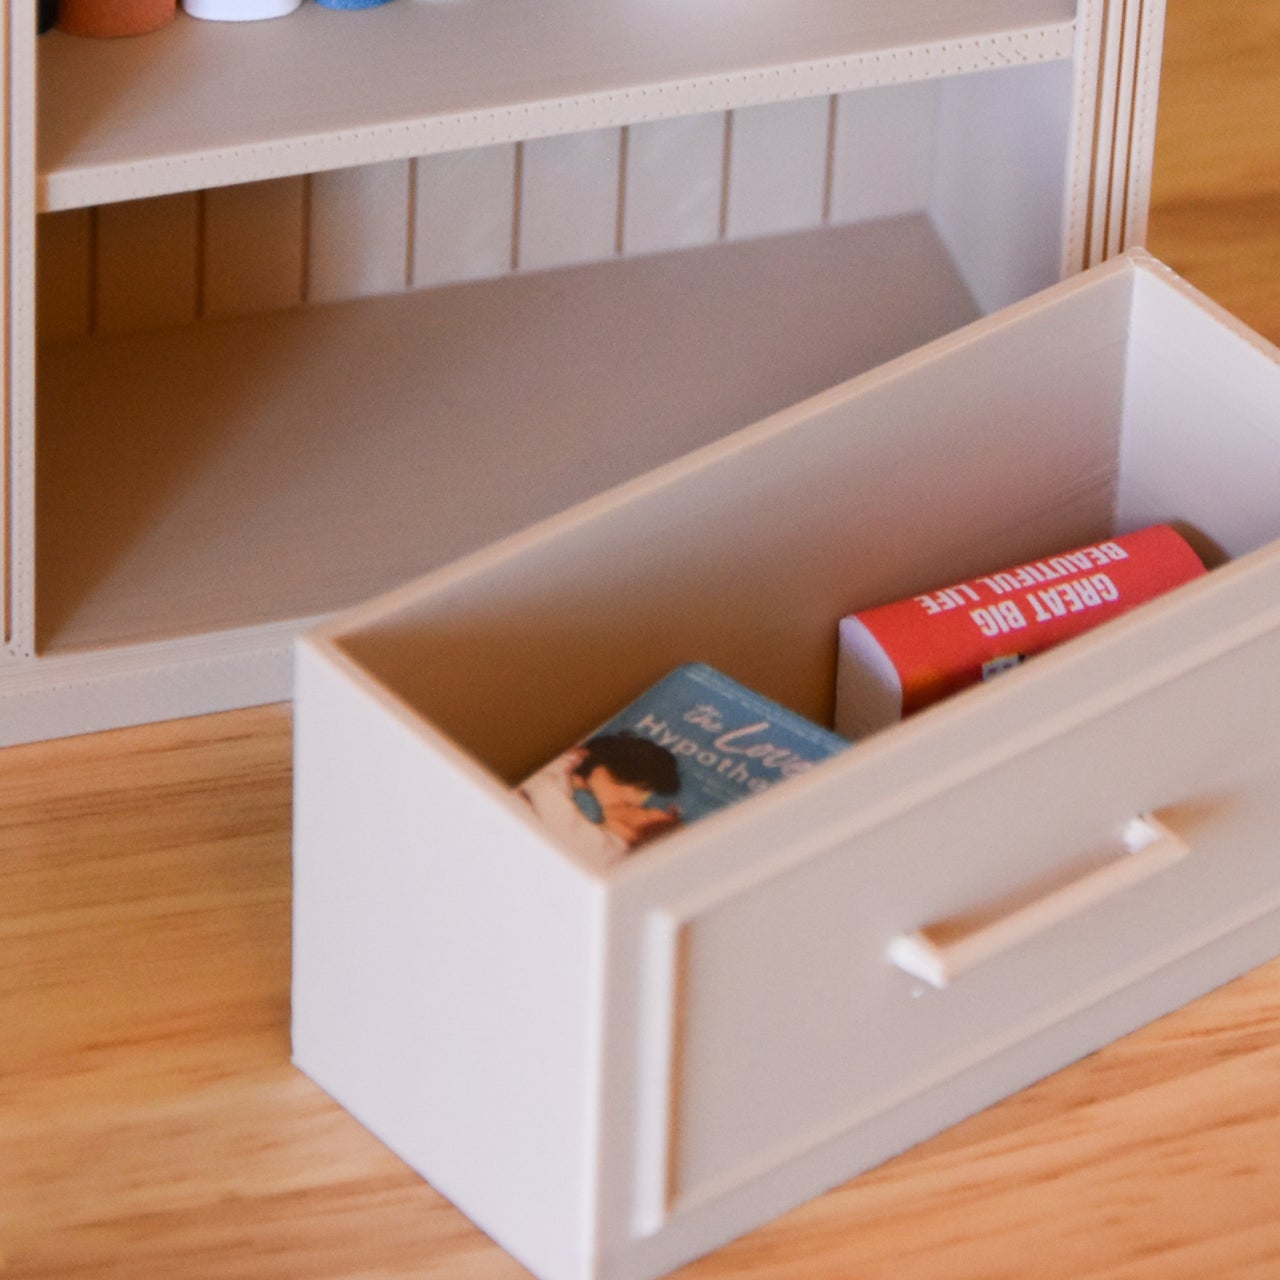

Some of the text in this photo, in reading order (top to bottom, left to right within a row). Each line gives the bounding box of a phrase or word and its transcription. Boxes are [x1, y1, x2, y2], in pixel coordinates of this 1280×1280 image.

[914, 541, 1130, 616] BEAUTIFUL LIFE
[969, 572, 1120, 638] GREAT BIG
